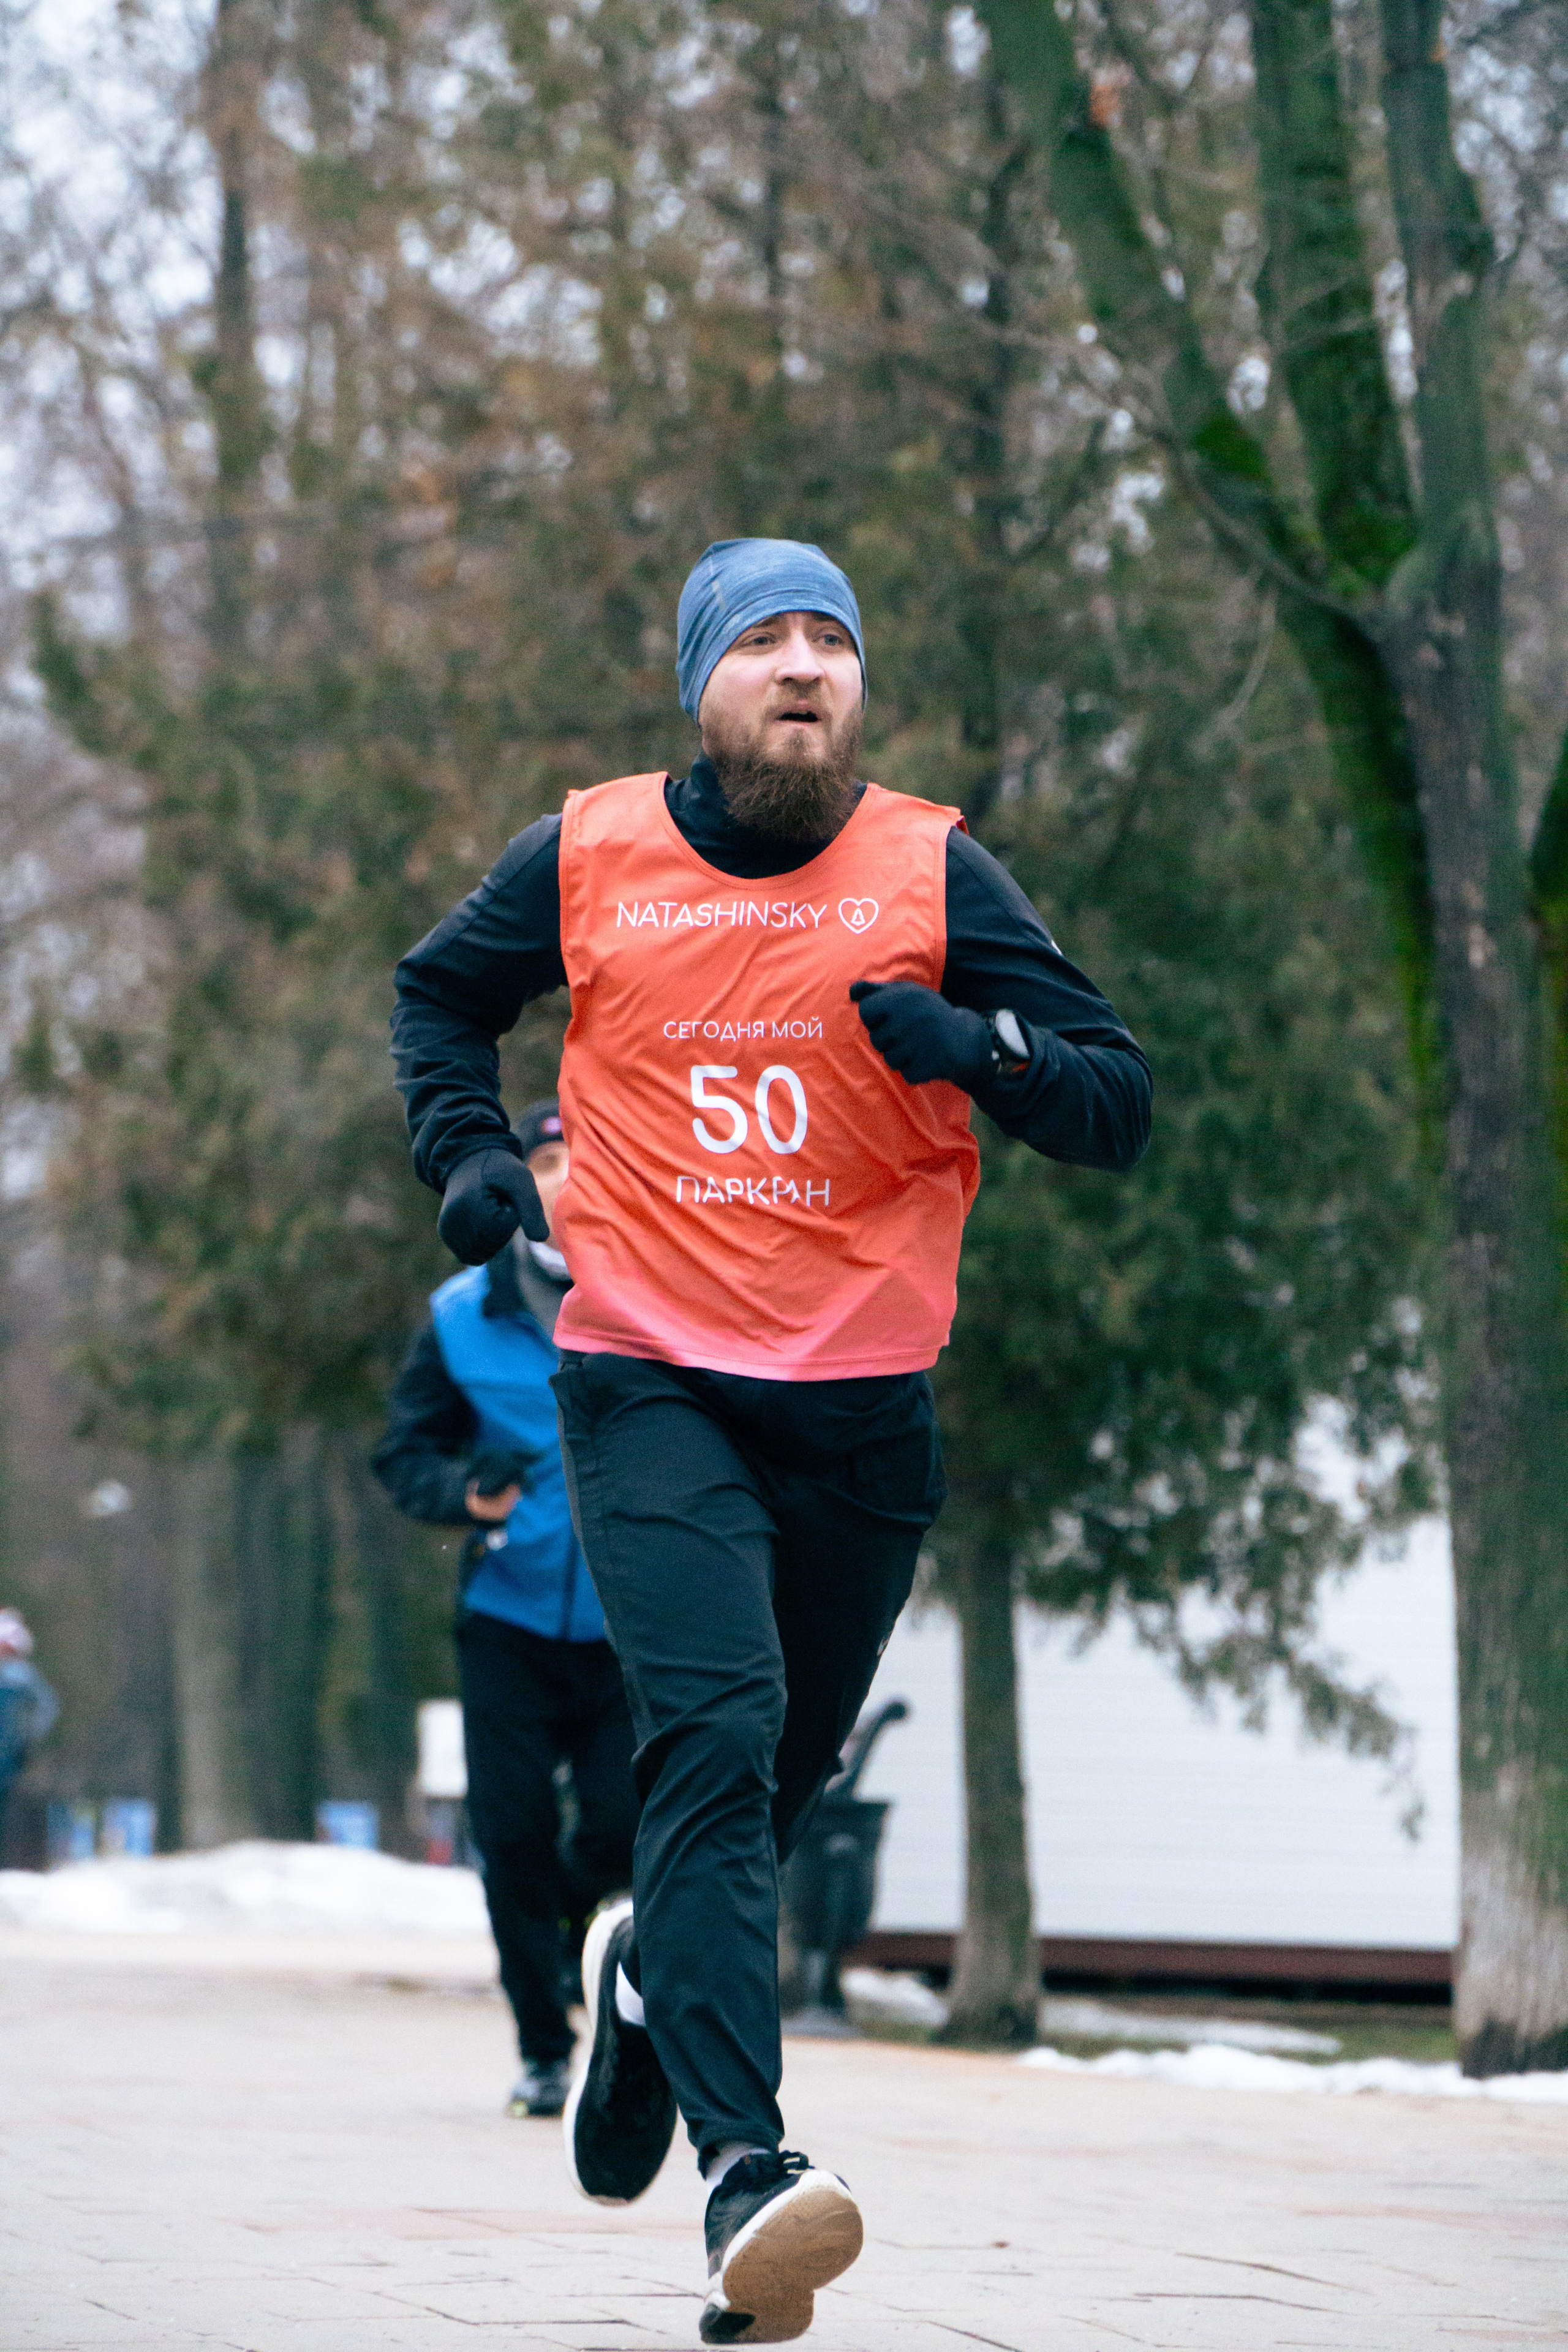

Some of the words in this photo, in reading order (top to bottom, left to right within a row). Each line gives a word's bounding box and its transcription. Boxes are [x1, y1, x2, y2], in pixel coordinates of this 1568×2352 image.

[616, 900, 827, 928] NATASHINSKY
[663, 1020, 764, 1042] СЕГОДНЯ
[771, 1017, 822, 1038] МОЙ
[690, 1065, 809, 1154] 50
